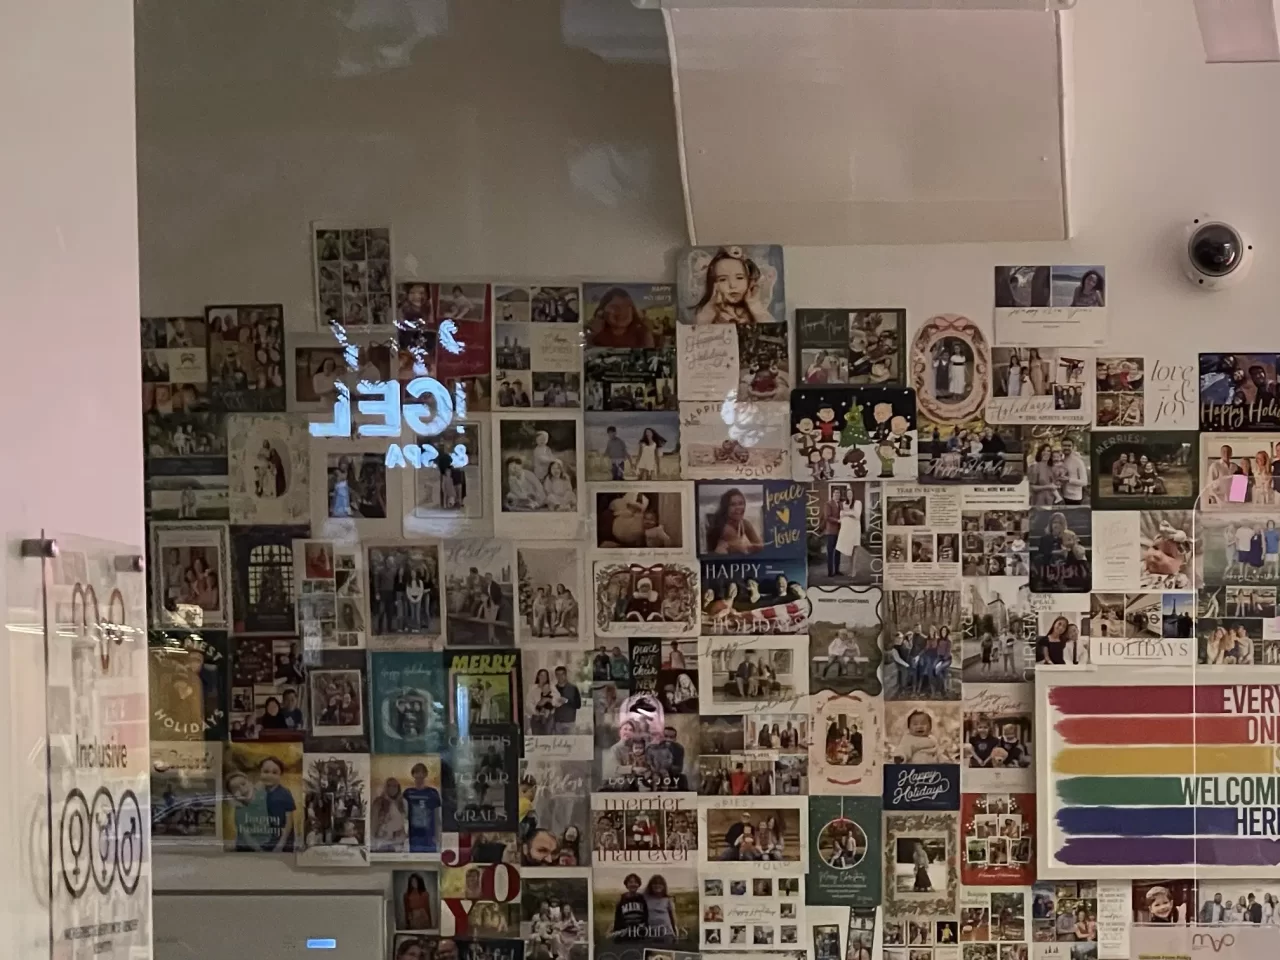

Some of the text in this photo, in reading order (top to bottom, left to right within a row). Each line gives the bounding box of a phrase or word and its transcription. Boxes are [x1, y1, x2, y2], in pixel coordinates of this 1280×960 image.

[1150, 359, 1194, 381] love
[1154, 396, 1186, 423] joy
[1201, 402, 1243, 427] Happy
[773, 529, 800, 548] love
[870, 501, 883, 586] HOLIDAYS
[706, 564, 760, 579] HAPPY
[1100, 643, 1188, 656] HOLIDAYS
[451, 654, 517, 673] MERRY
[154, 709, 224, 734] HOLIDAYS
[76, 734, 128, 768] Inclusive
[899, 770, 942, 787] Happy
[892, 778, 950, 804] Holidays
[604, 796, 685, 811] merrier
[244, 812, 280, 827] happy
[628, 925, 688, 939] HOLIDAYS
